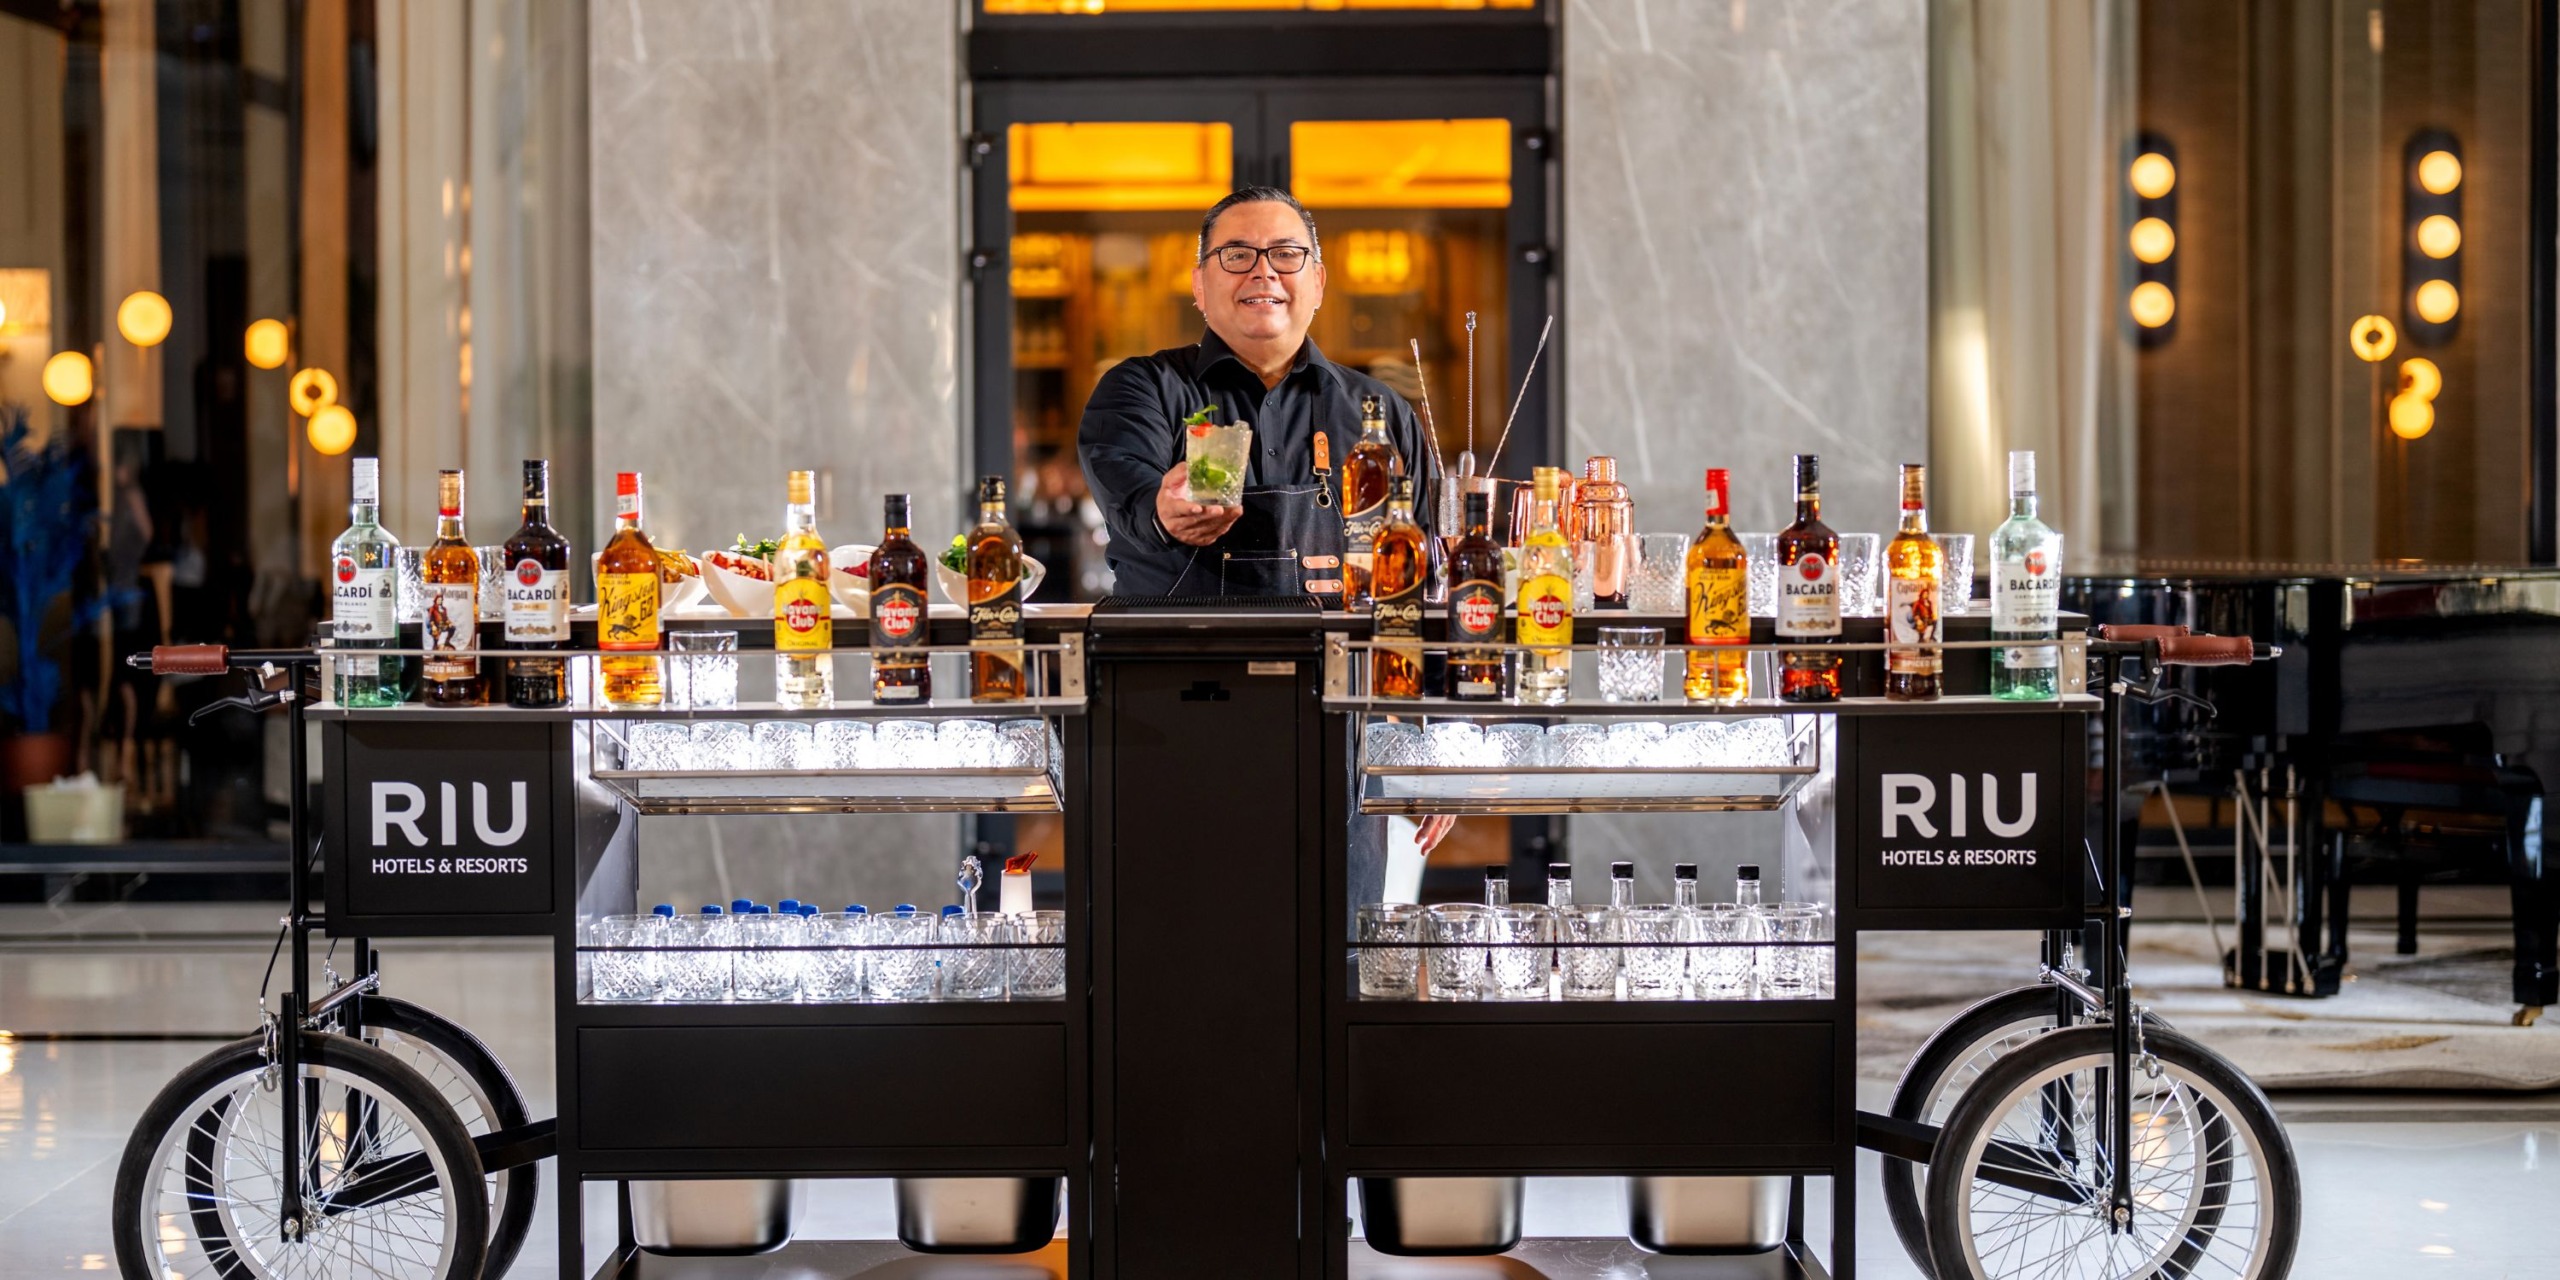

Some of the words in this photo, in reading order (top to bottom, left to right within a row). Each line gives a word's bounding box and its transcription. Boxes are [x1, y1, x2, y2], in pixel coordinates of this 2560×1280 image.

[333, 583, 373, 598] ACARDÍ
[2010, 579, 2056, 591] BACARD
[507, 585, 557, 600] BACARDÍ
[640, 595, 654, 621] 62
[876, 604, 919, 617] Havana
[1456, 600, 1499, 613] Havana
[788, 614, 816, 628] Club
[884, 617, 911, 629] Club
[1465, 612, 1491, 625] Club
[1535, 611, 1561, 624] Club
[424, 665, 445, 673] PICED
[1881, 772, 2037, 839] RIU
[371, 781, 528, 847] RIU
[1882, 849, 1944, 866] HOTELS
[1947, 849, 1961, 866] &
[1964, 849, 2037, 865] RESORTS
[372, 858, 435, 874] HOTELS
[438, 858, 452, 874] &
[455, 857, 528, 874] RESORTS
